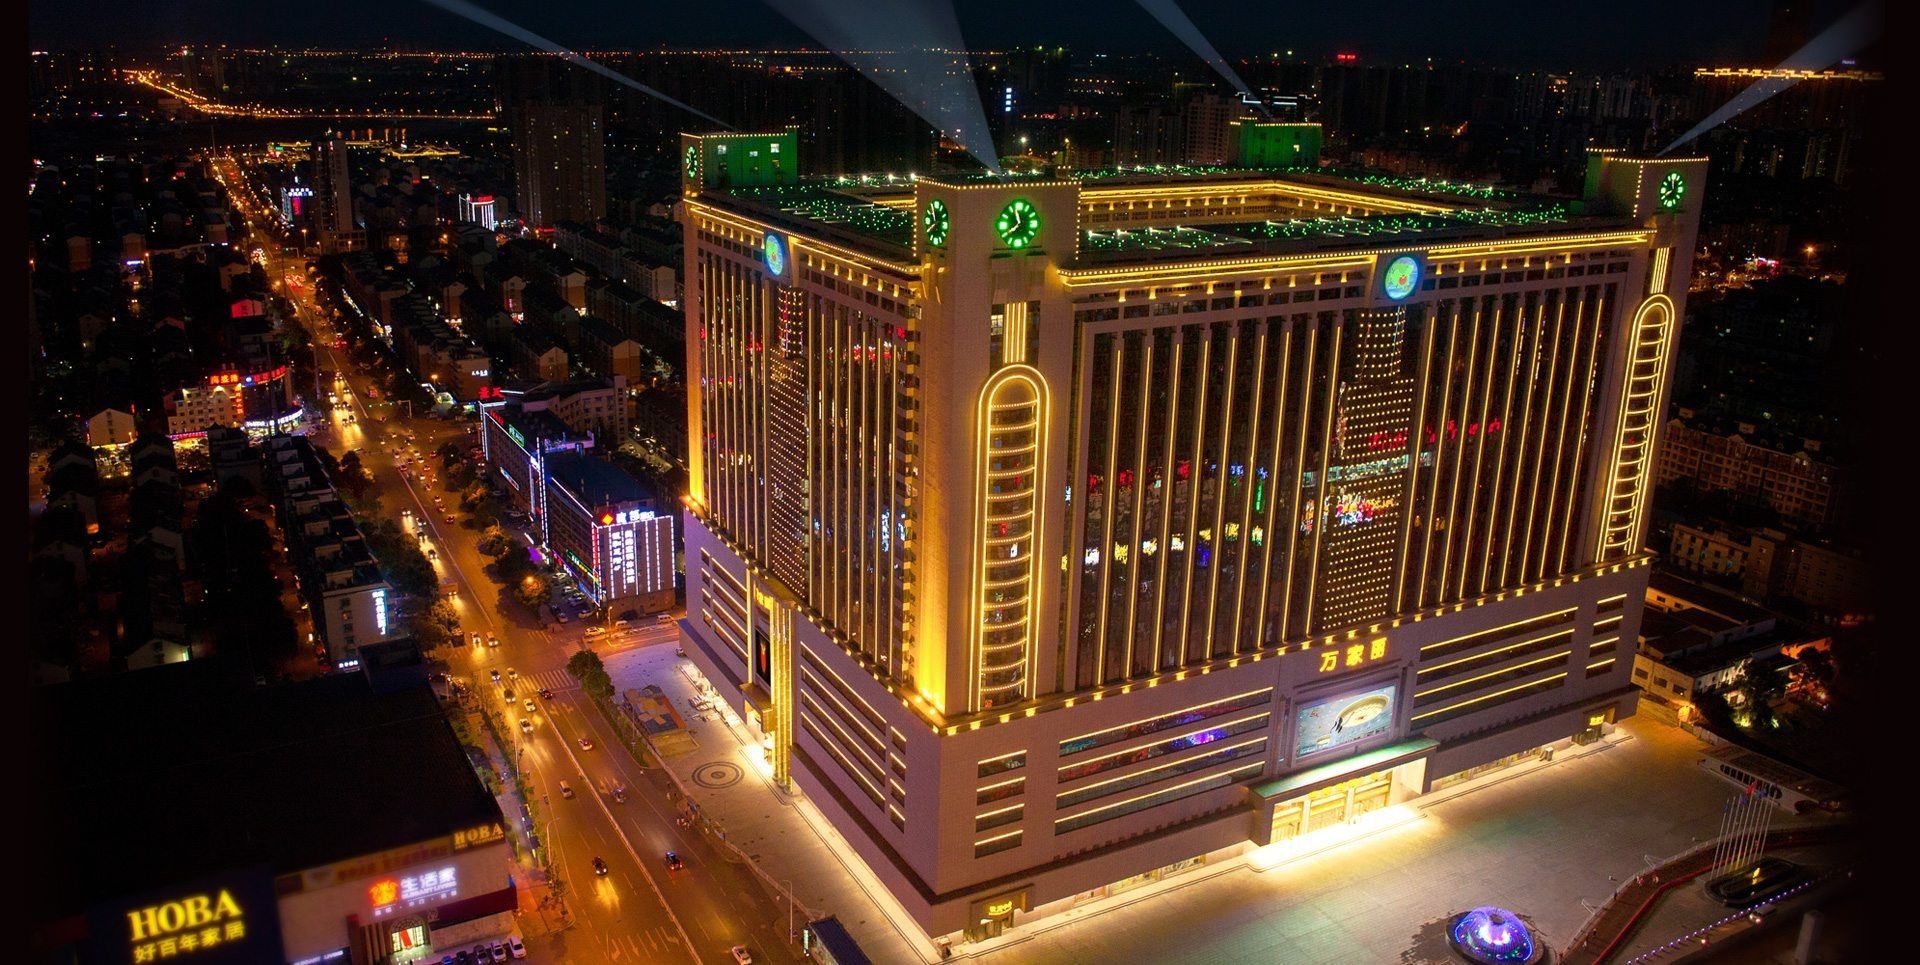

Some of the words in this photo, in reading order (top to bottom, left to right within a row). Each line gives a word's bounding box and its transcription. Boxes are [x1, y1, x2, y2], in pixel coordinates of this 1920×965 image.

[454, 823, 503, 845] HOBA
[401, 867, 456, 892] 生活家
[127, 889, 242, 941] HOBA
[134, 921, 245, 964] 好百年家居
